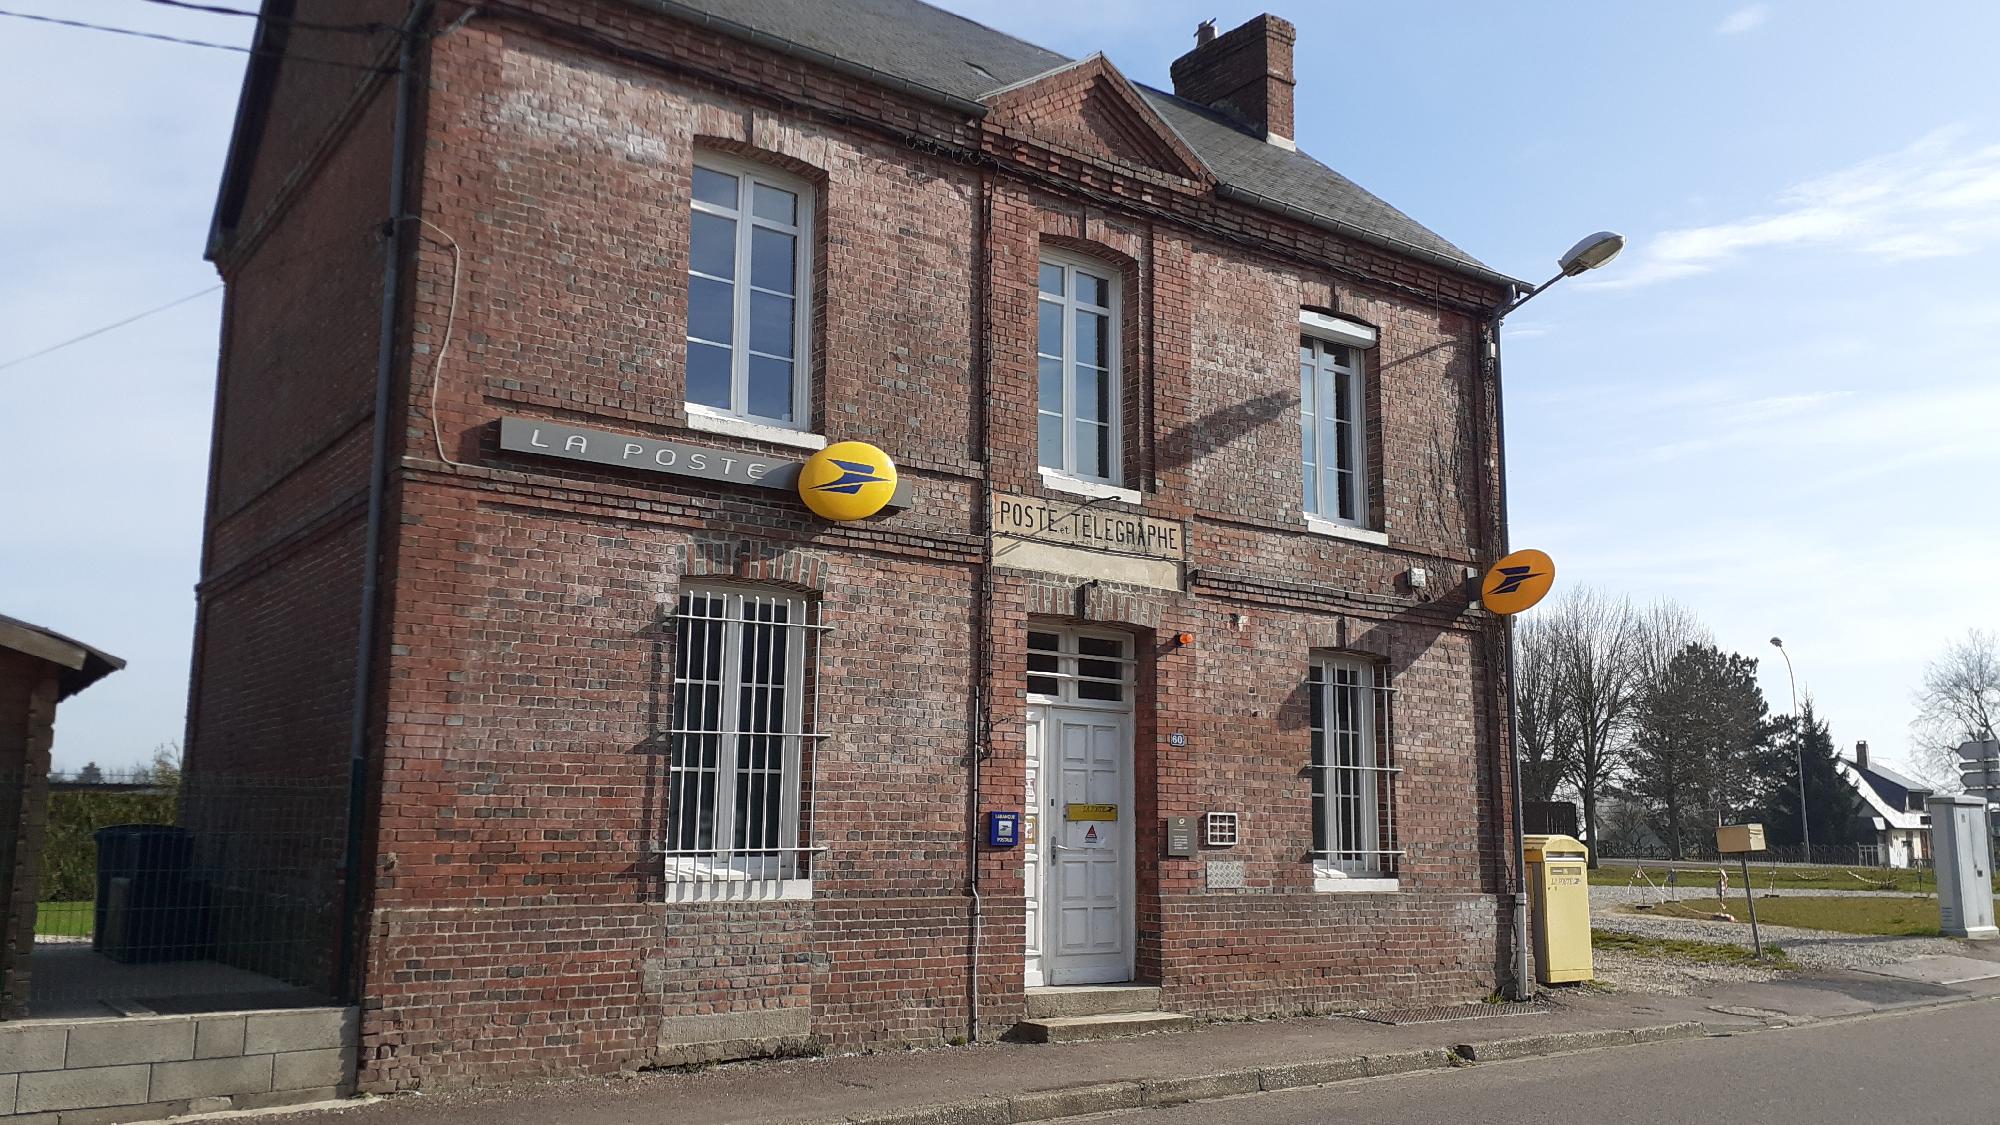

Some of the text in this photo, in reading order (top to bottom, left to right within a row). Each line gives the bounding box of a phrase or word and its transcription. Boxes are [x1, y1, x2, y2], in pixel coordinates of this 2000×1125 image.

[530, 428, 767, 480] LA POSTE
[1000, 501, 1178, 550] POSTE et TELEGRAPHE
[1172, 735, 1183, 744] 60
